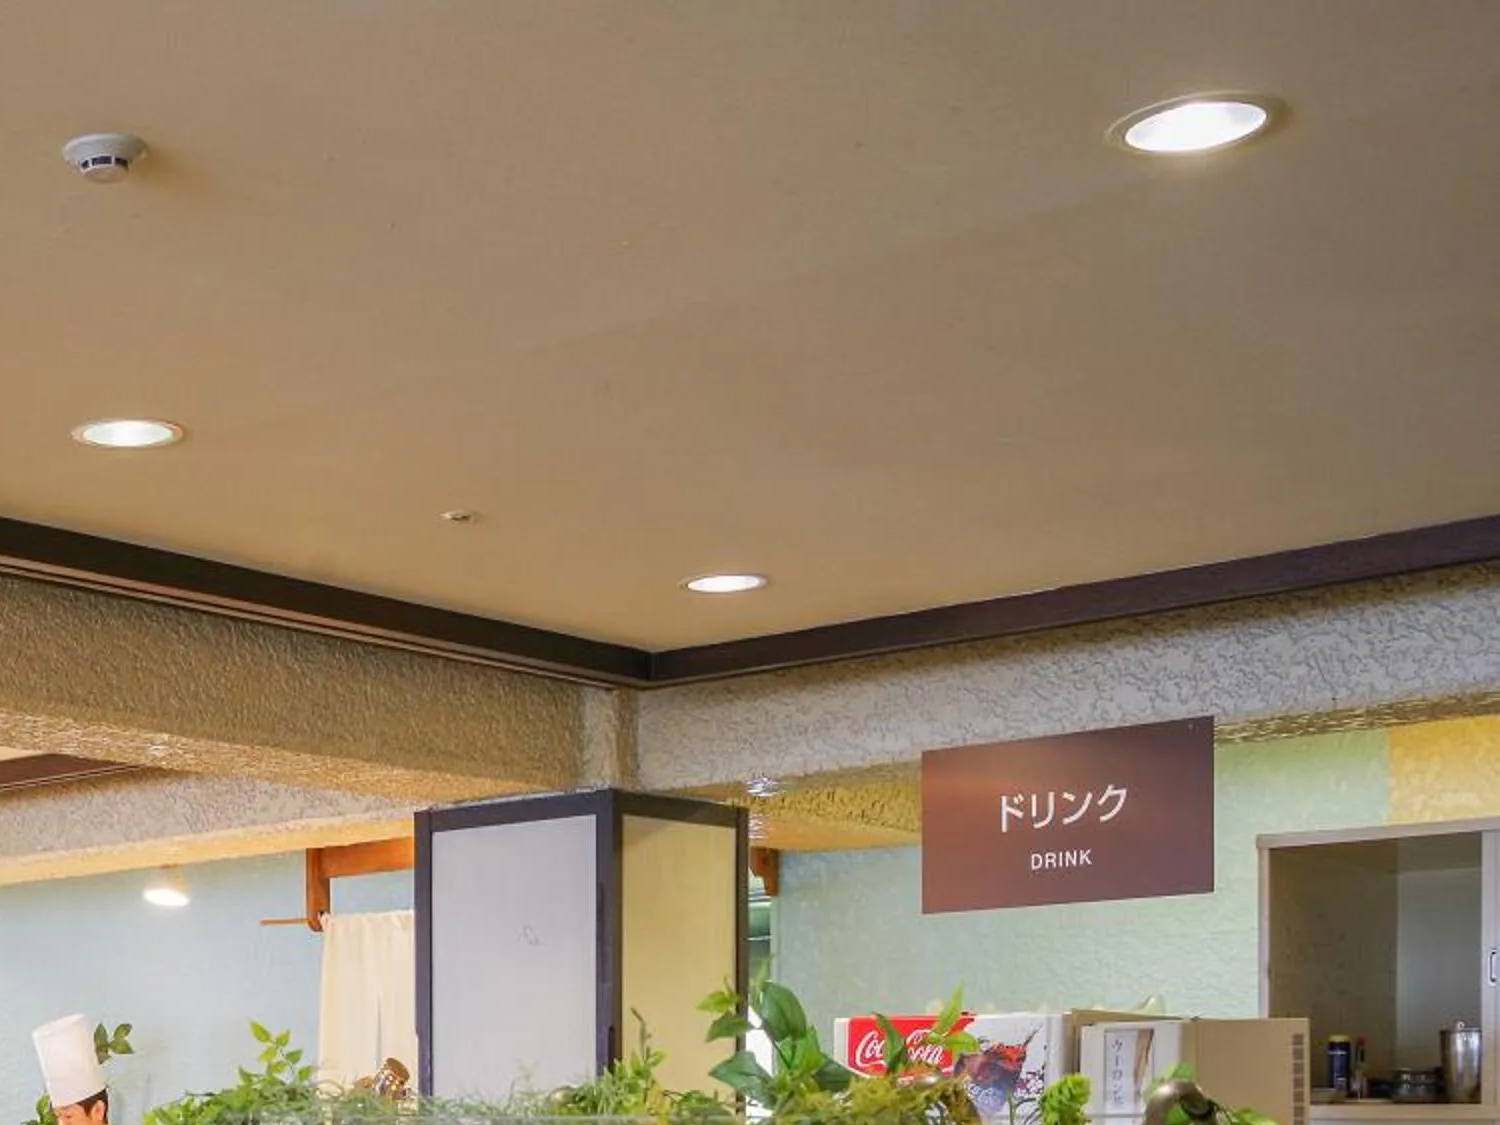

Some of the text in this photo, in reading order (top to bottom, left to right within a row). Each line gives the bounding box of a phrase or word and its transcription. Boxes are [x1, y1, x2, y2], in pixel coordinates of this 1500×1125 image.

[1000, 784, 1128, 833] ドリンク
[1030, 849, 1093, 871] DRINK
